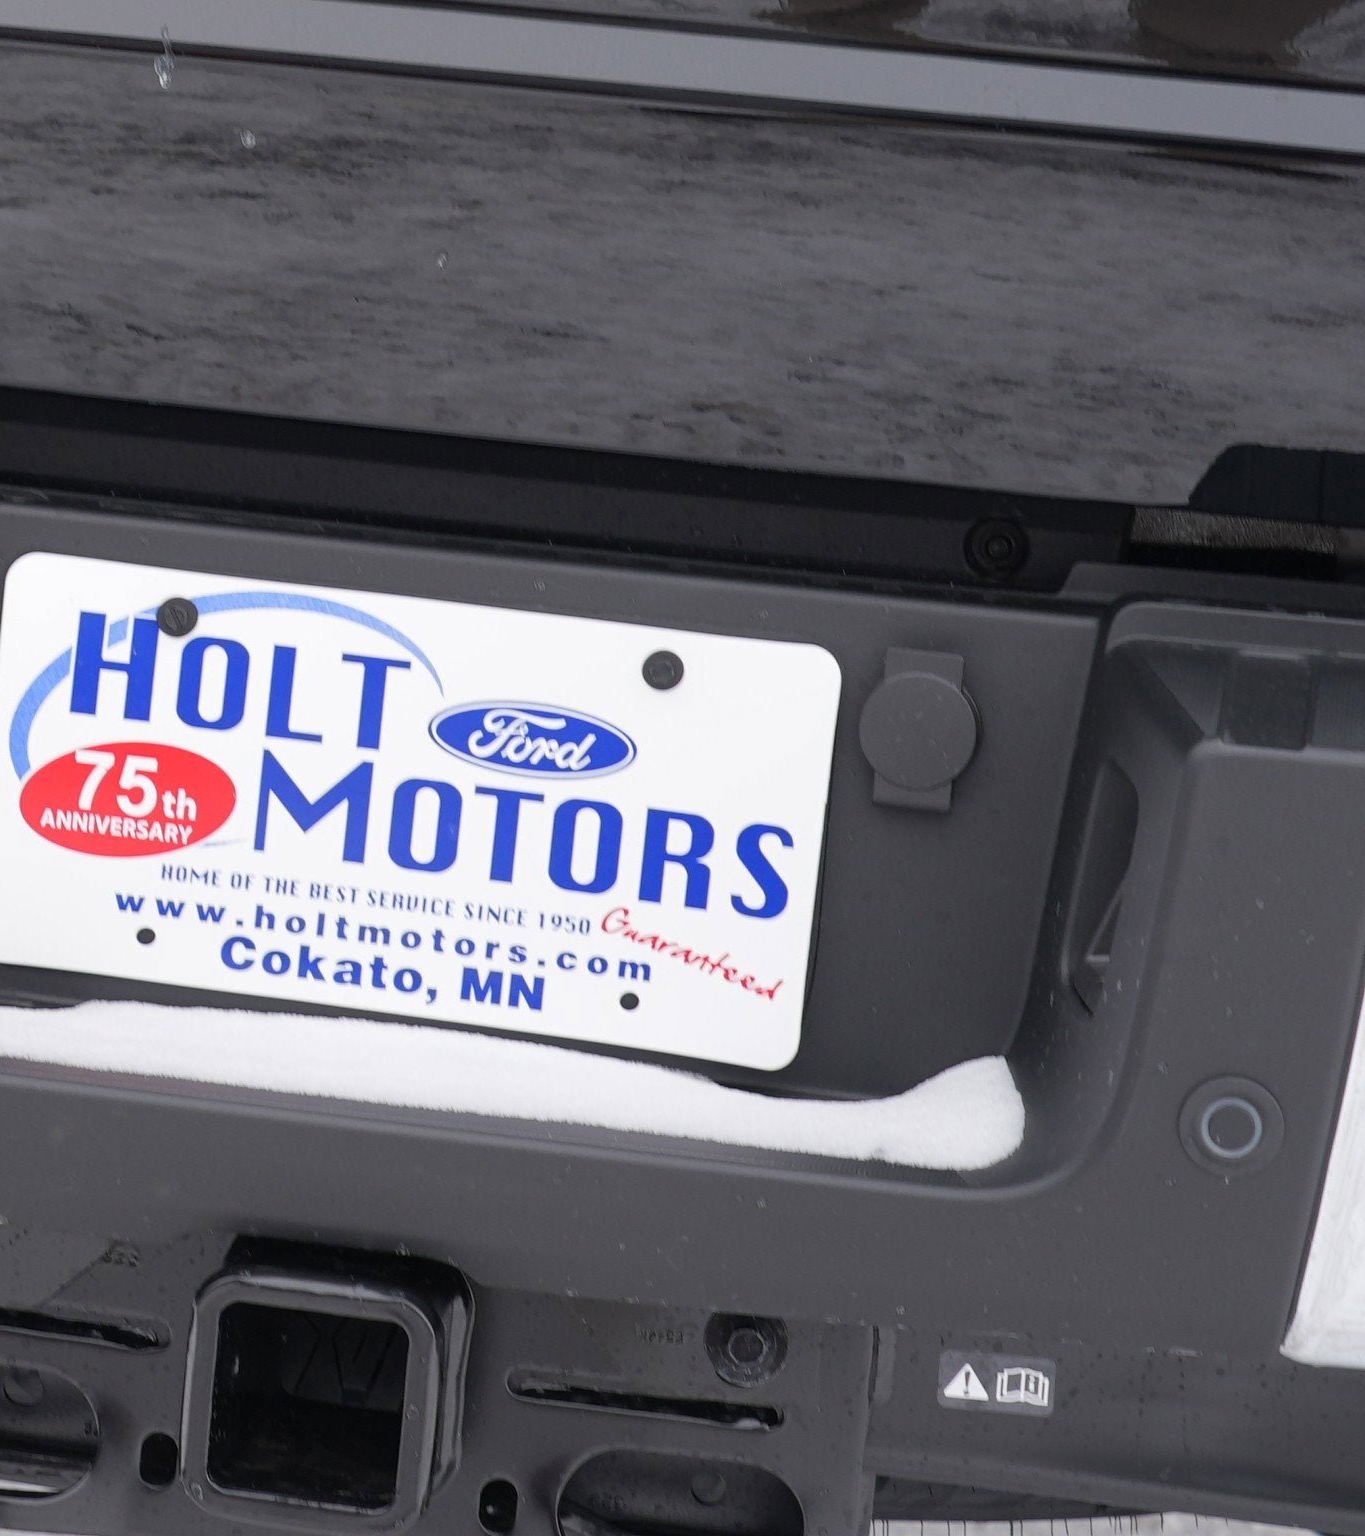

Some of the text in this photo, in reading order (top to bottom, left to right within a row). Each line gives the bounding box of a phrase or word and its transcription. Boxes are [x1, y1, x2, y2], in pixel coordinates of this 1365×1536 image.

[70, 611, 411, 750] HOLT
[468, 708, 597, 771] Ford
[40, 807, 193, 846] ANNIVERSARY
[75, 749, 197, 822] 75th
[254, 749, 794, 919] MOTORS
[115, 892, 652, 983] www.holtmotors.com
[160, 864, 785, 1002] HOME OF THE BEST SERVICE SINCE 1950 Guaranteed
[220, 935, 546, 1012] Cokato, MN
